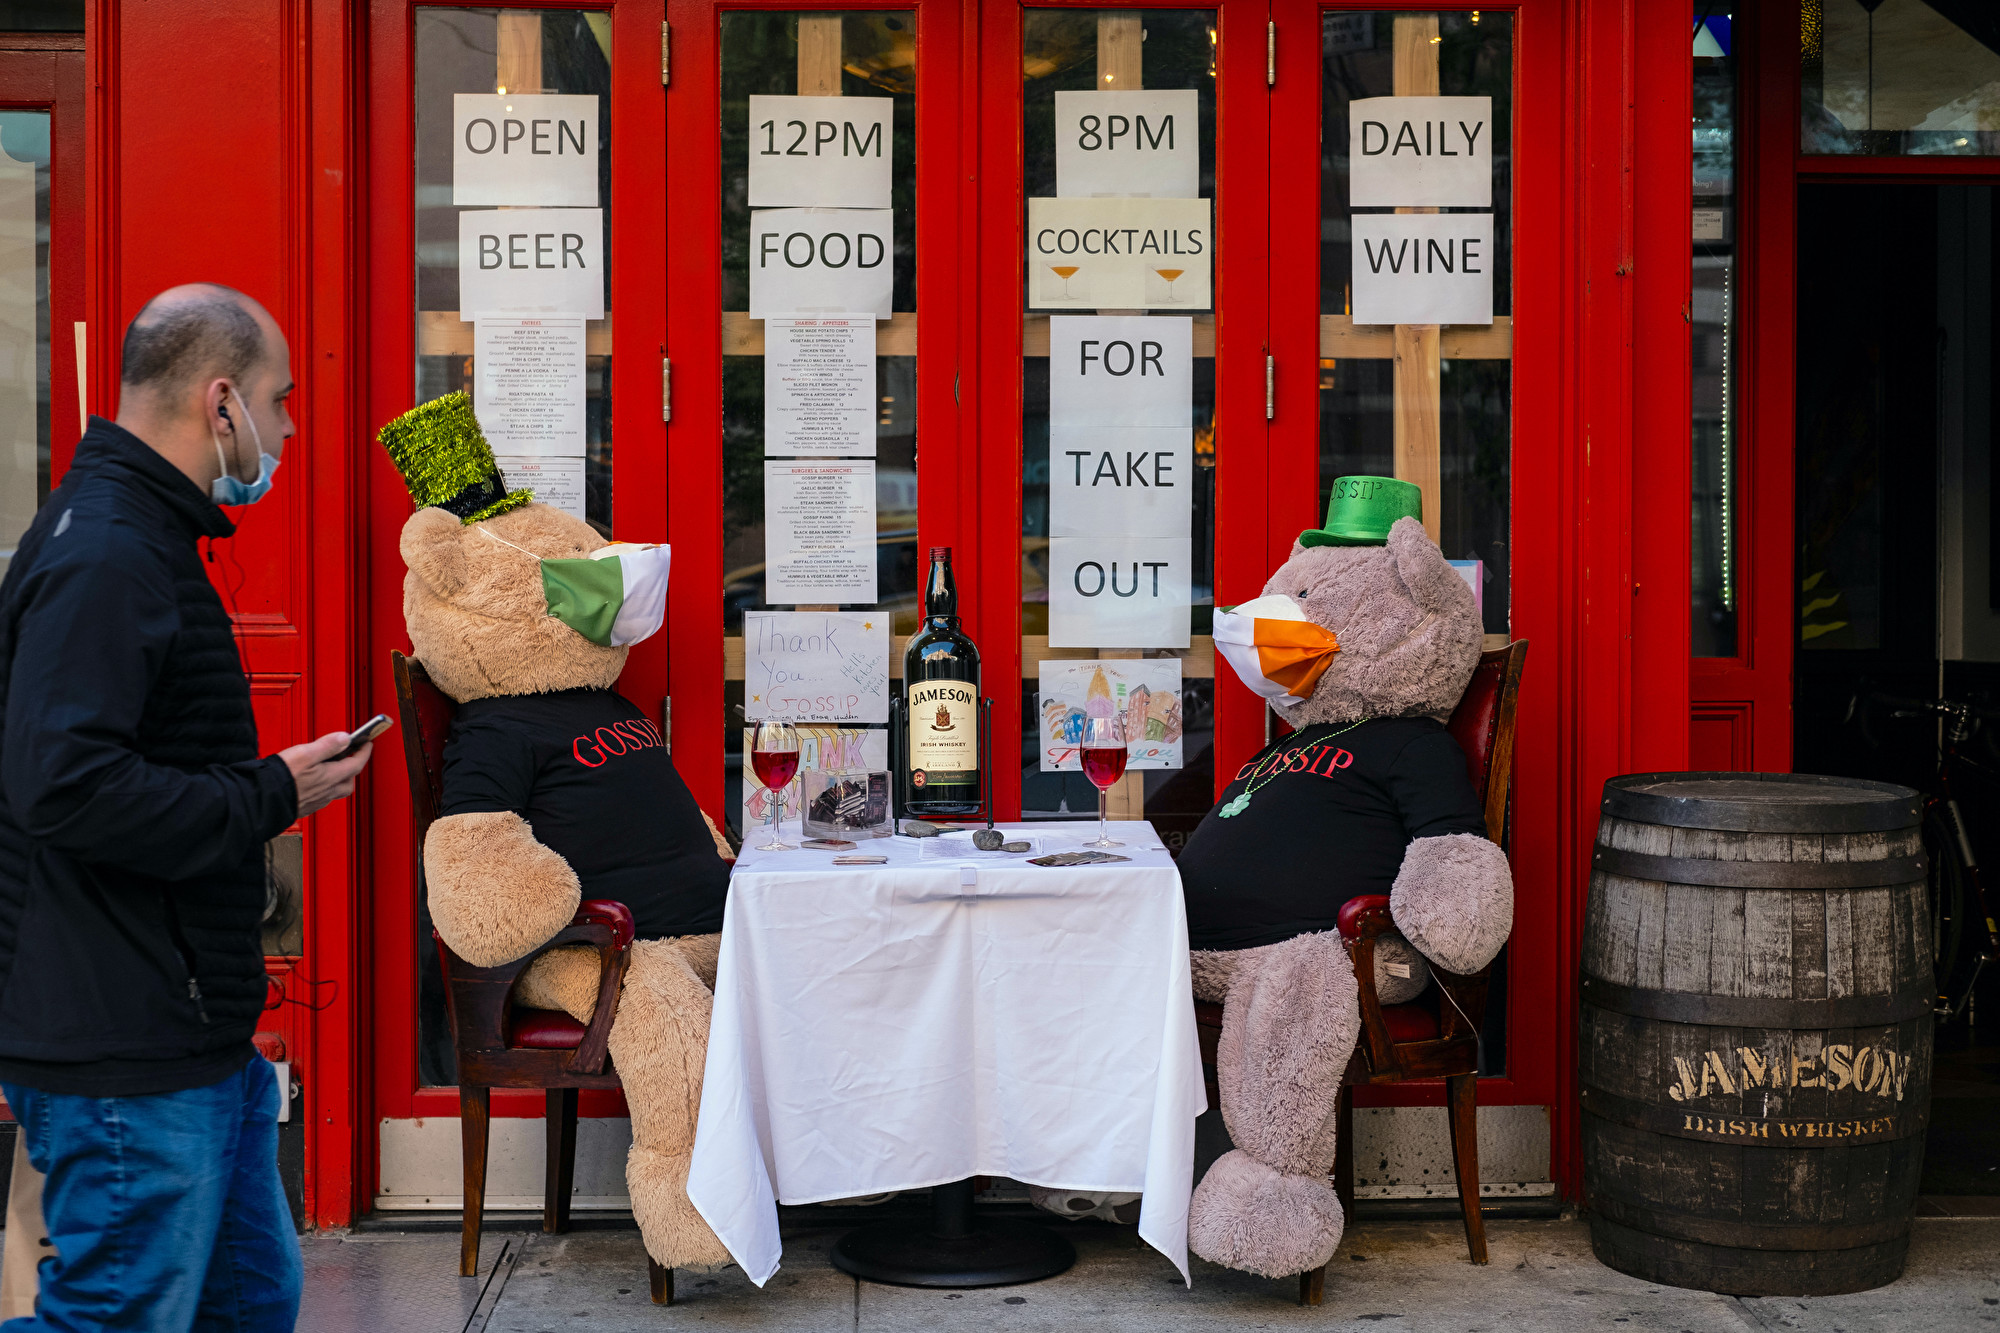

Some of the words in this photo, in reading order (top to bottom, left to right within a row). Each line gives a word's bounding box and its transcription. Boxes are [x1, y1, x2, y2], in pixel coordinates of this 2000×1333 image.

[466, 119, 584, 155] OPEN
[761, 121, 881, 157] 12PM
[1079, 115, 1173, 150] 8PM
[1362, 121, 1483, 156] DAILY
[480, 234, 585, 269] BEER
[761, 233, 884, 268] FOOD
[1038, 229, 1202, 254] COCKTAILS
[1364, 239, 1481, 273] WINE
[1081, 341, 1164, 376] FOR
[1066, 451, 1174, 486] TAKE
[1075, 562, 1168, 597] OUT
[749, 616, 843, 659] Thank
[840, 653, 866, 678] Hell's
[913, 688, 972, 706] JAMESON
[1668, 1044, 1911, 1102] JAMESON
[1683, 1114, 1770, 1138] IRISH
[1778, 1115, 1897, 1138] WHISKEY
